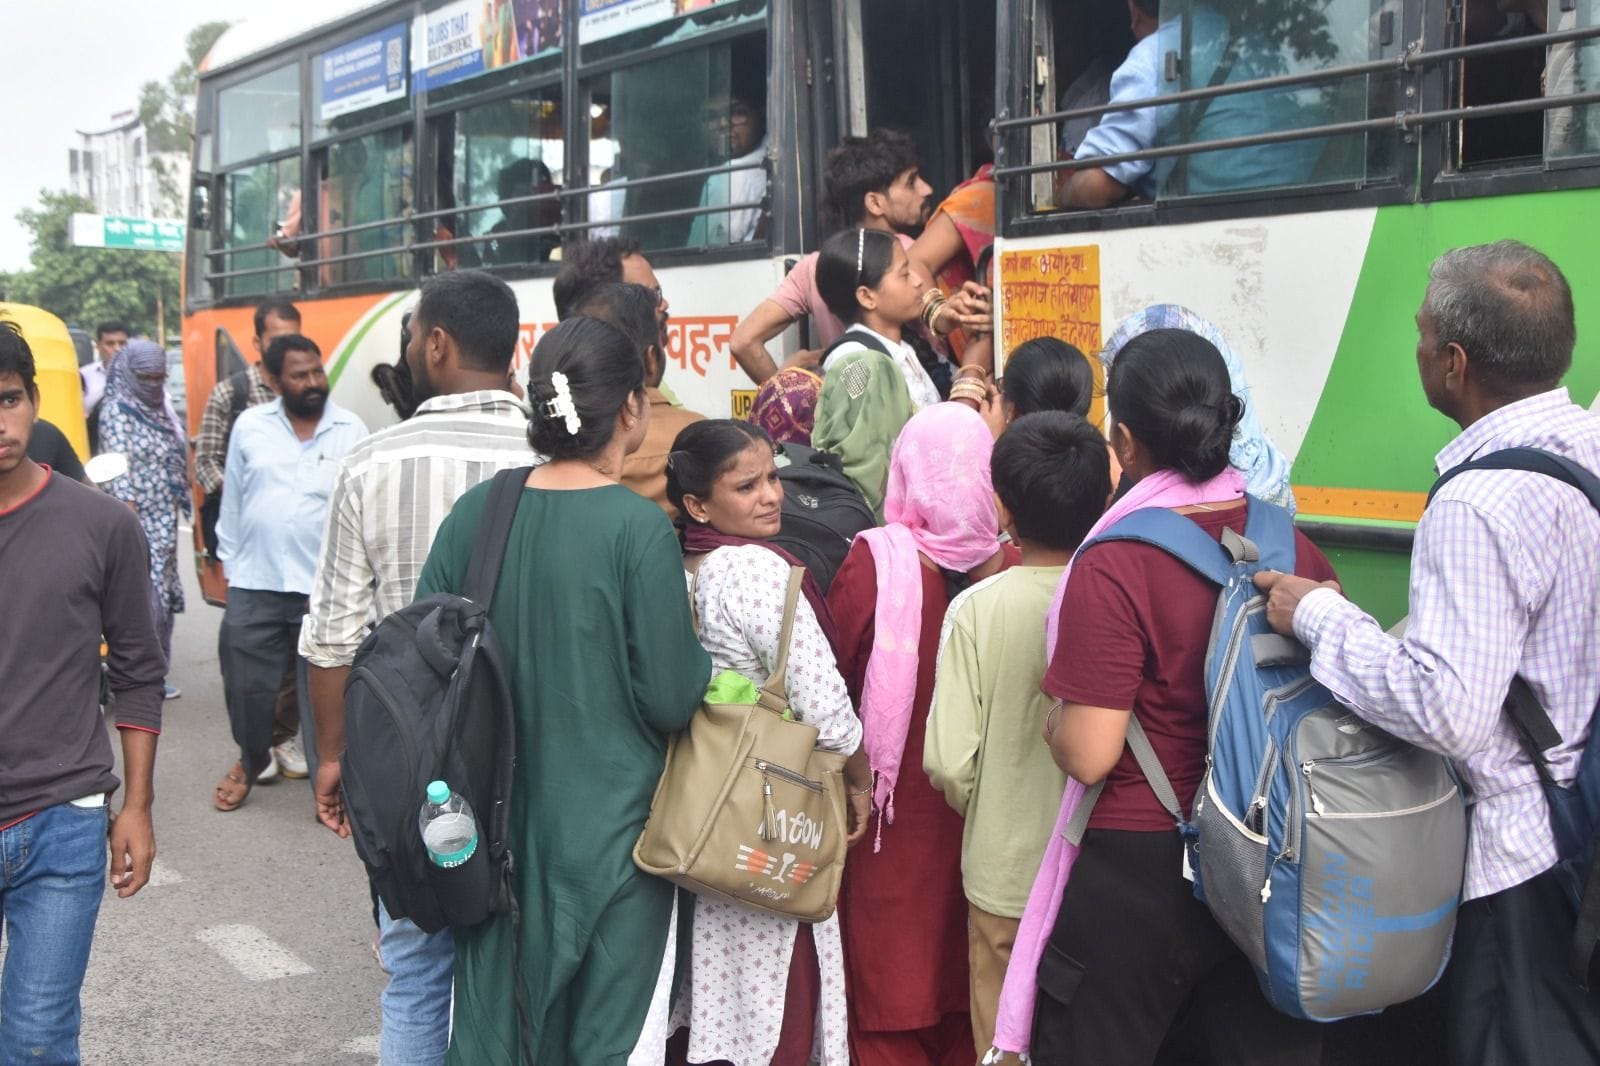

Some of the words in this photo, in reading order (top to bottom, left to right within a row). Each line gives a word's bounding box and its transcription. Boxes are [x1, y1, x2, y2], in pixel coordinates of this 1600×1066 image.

[427, 20, 449, 46] CLUBS
[451, 12, 469, 38] THAT
[442, 33, 473, 58] CONFIDENCE
[1040, 249, 1085, 277] अयोध्या
[1316, 851, 1350, 1003] ERCAN
[1344, 876, 1375, 991] RIDER
